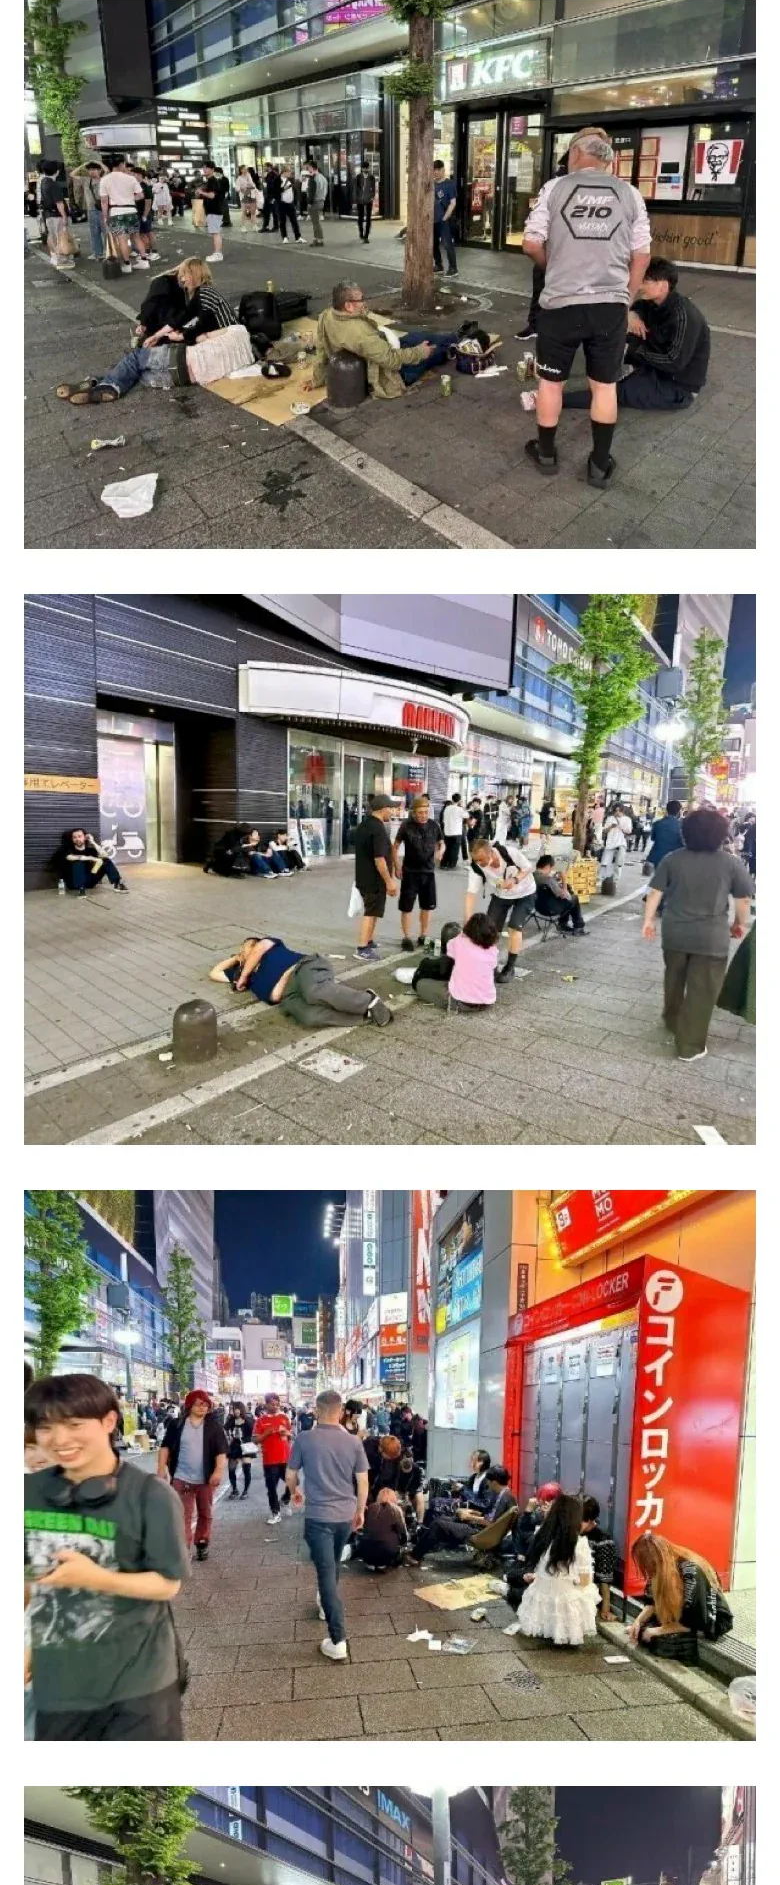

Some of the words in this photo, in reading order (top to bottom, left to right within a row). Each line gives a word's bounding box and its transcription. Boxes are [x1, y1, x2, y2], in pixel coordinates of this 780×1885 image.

[472, 50, 534, 86] KFC
[570, 205, 612, 218] 210
[576, 194, 615, 205] VMF
[547, 629, 568, 659] TOHO
[634, 1316, 675, 1530] コインロッカ
[377, 1790, 412, 1829] IMAX
